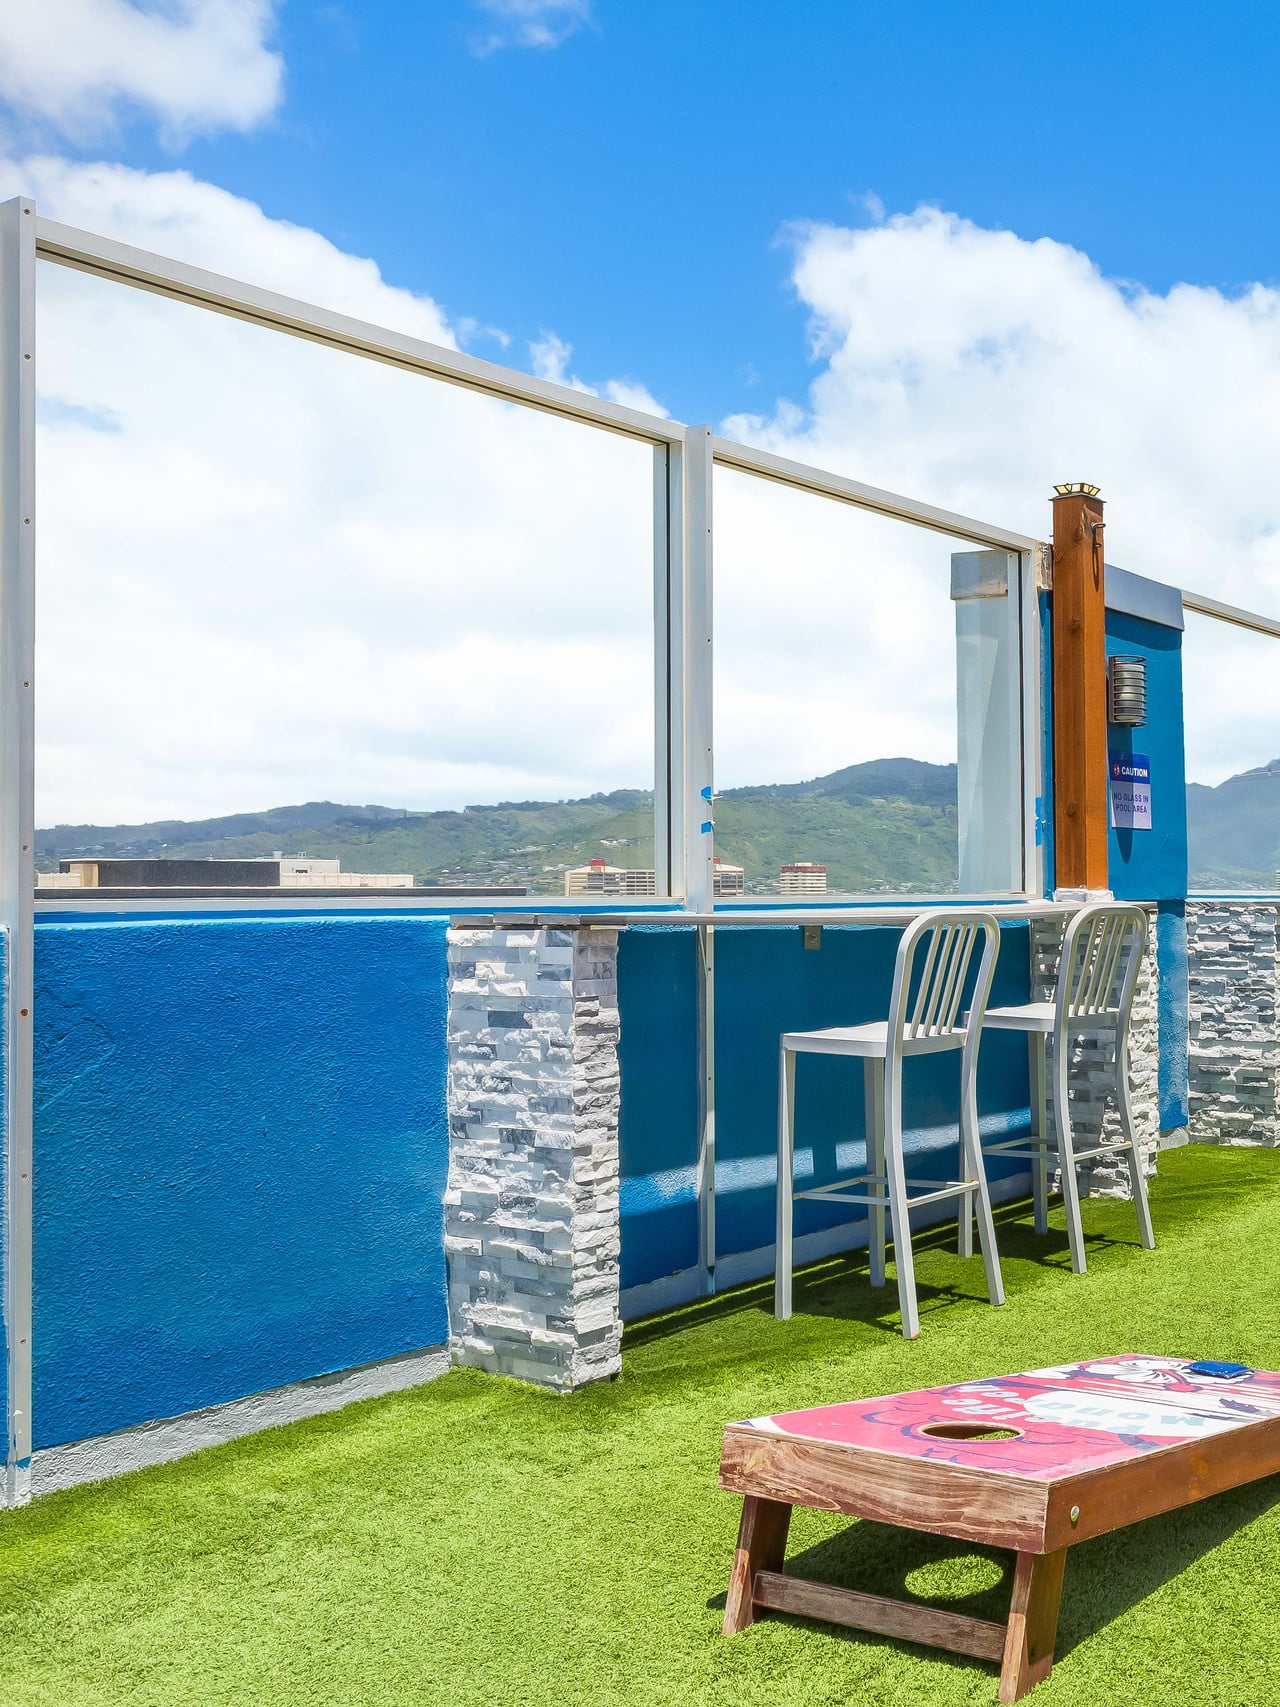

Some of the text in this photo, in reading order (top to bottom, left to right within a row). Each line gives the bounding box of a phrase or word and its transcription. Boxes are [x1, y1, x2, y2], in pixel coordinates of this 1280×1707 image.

[1121, 766, 1148, 778] CAUTION
[1113, 792, 1149, 803] NO GLASS IN
[1115, 803, 1148, 814] POOL AREA
